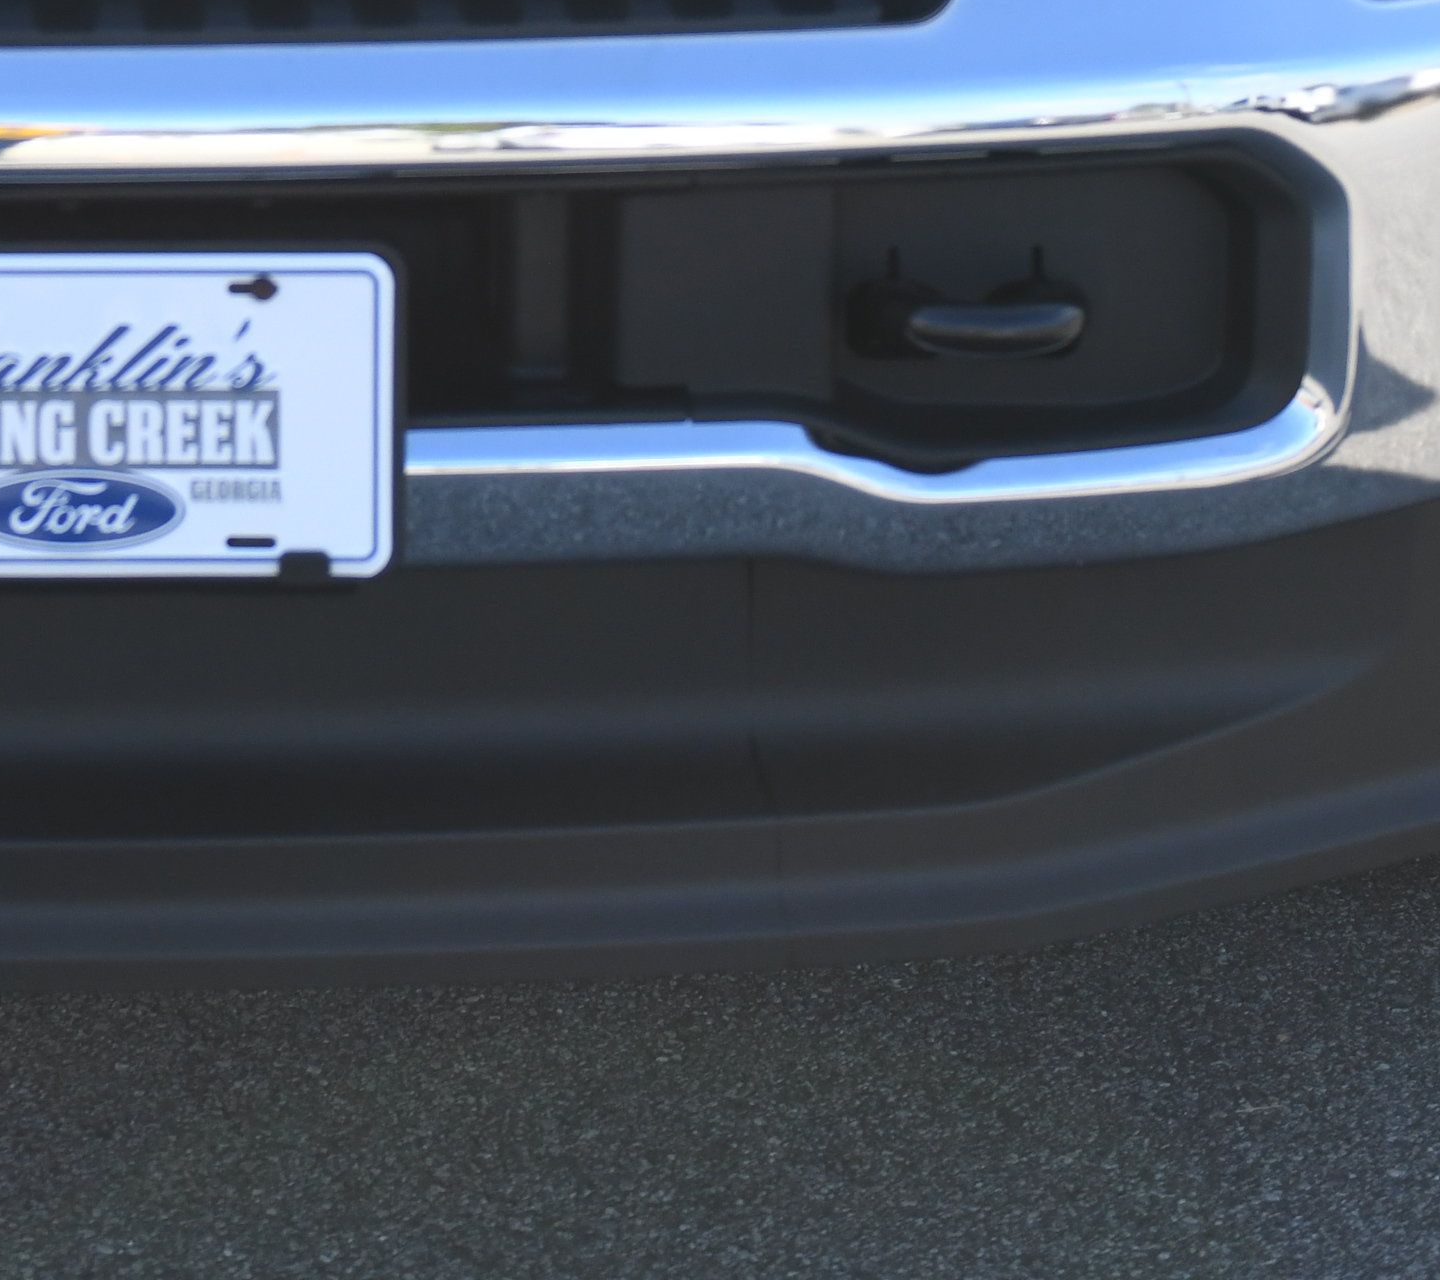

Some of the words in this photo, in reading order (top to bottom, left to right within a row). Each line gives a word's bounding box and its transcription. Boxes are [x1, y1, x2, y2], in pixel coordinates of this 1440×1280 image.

[90, 398, 276, 465] CREEK
[9, 478, 138, 536] Ford
[189, 476, 282, 504] GEORGIA
